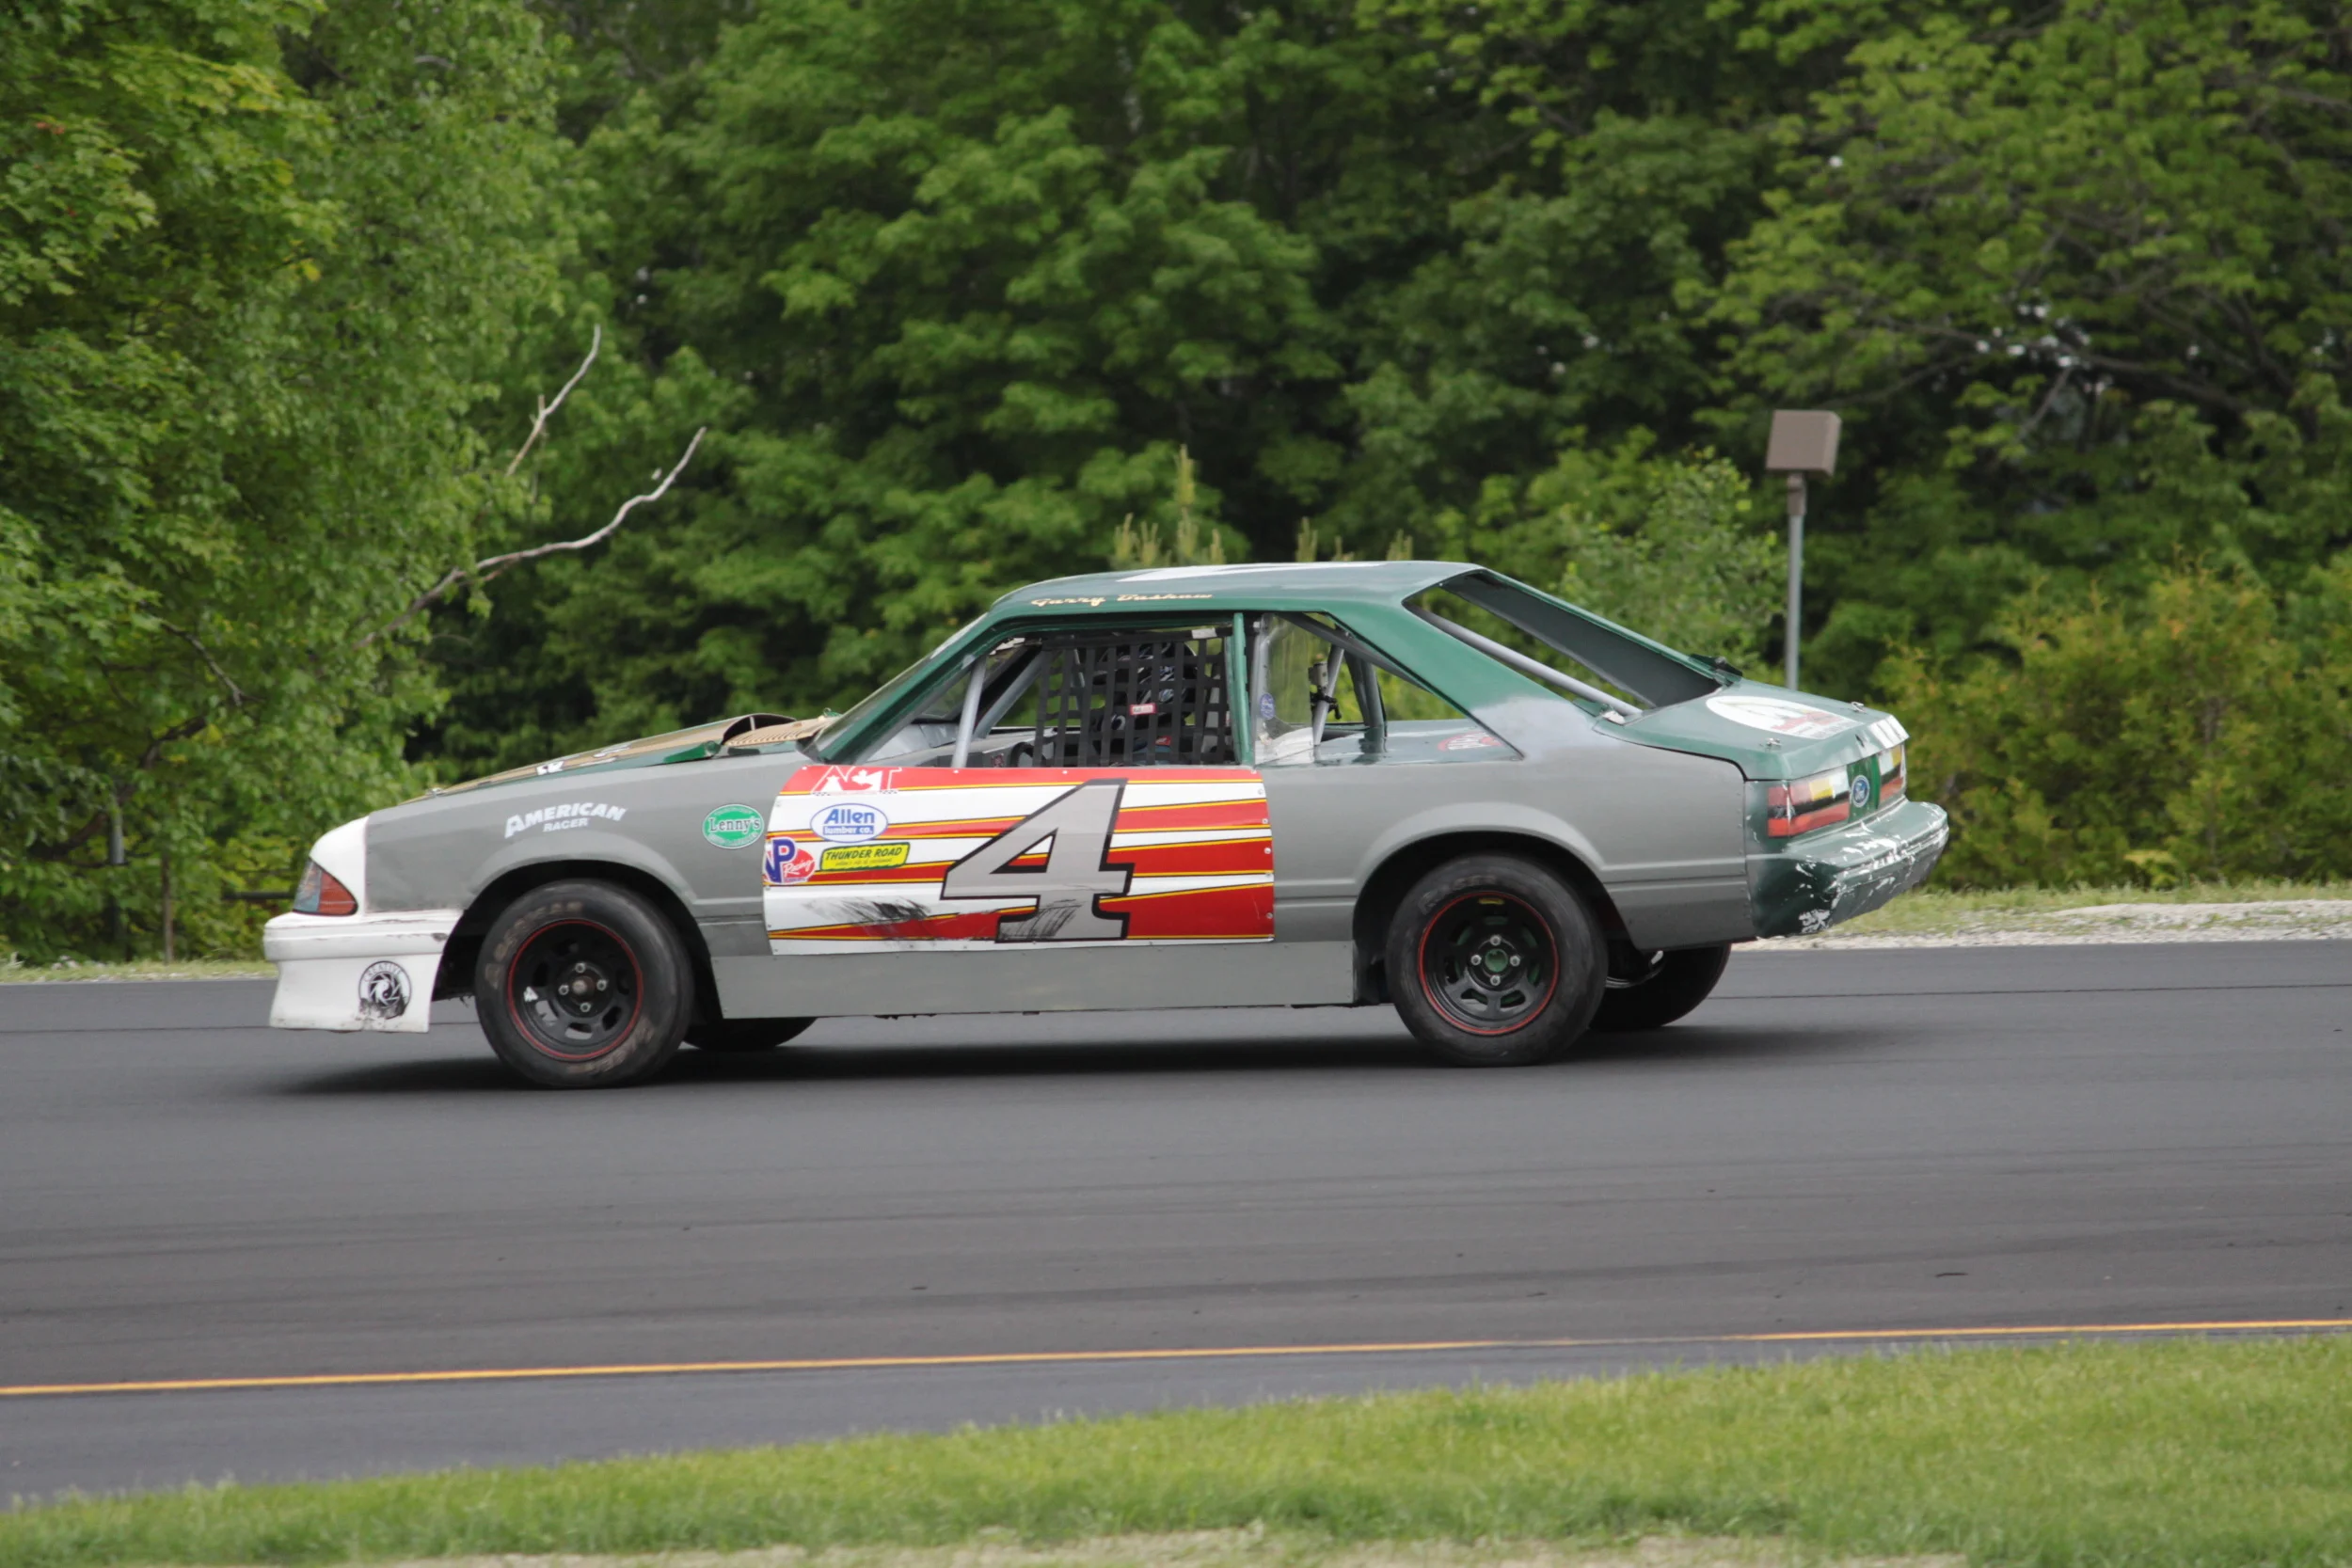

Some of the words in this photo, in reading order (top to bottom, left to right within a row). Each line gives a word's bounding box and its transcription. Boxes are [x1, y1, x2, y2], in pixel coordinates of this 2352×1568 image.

[504, 802, 628, 839] AMERICAN
[824, 809, 875, 824] Allen
[542, 817, 591, 832] RACER
[709, 816, 761, 834] Lenny's
[824, 826, 857, 834] lumber
[826, 849, 873, 861] THUNDER
[874, 847, 902, 858] ROAD
[940, 778, 1136, 943] 4
